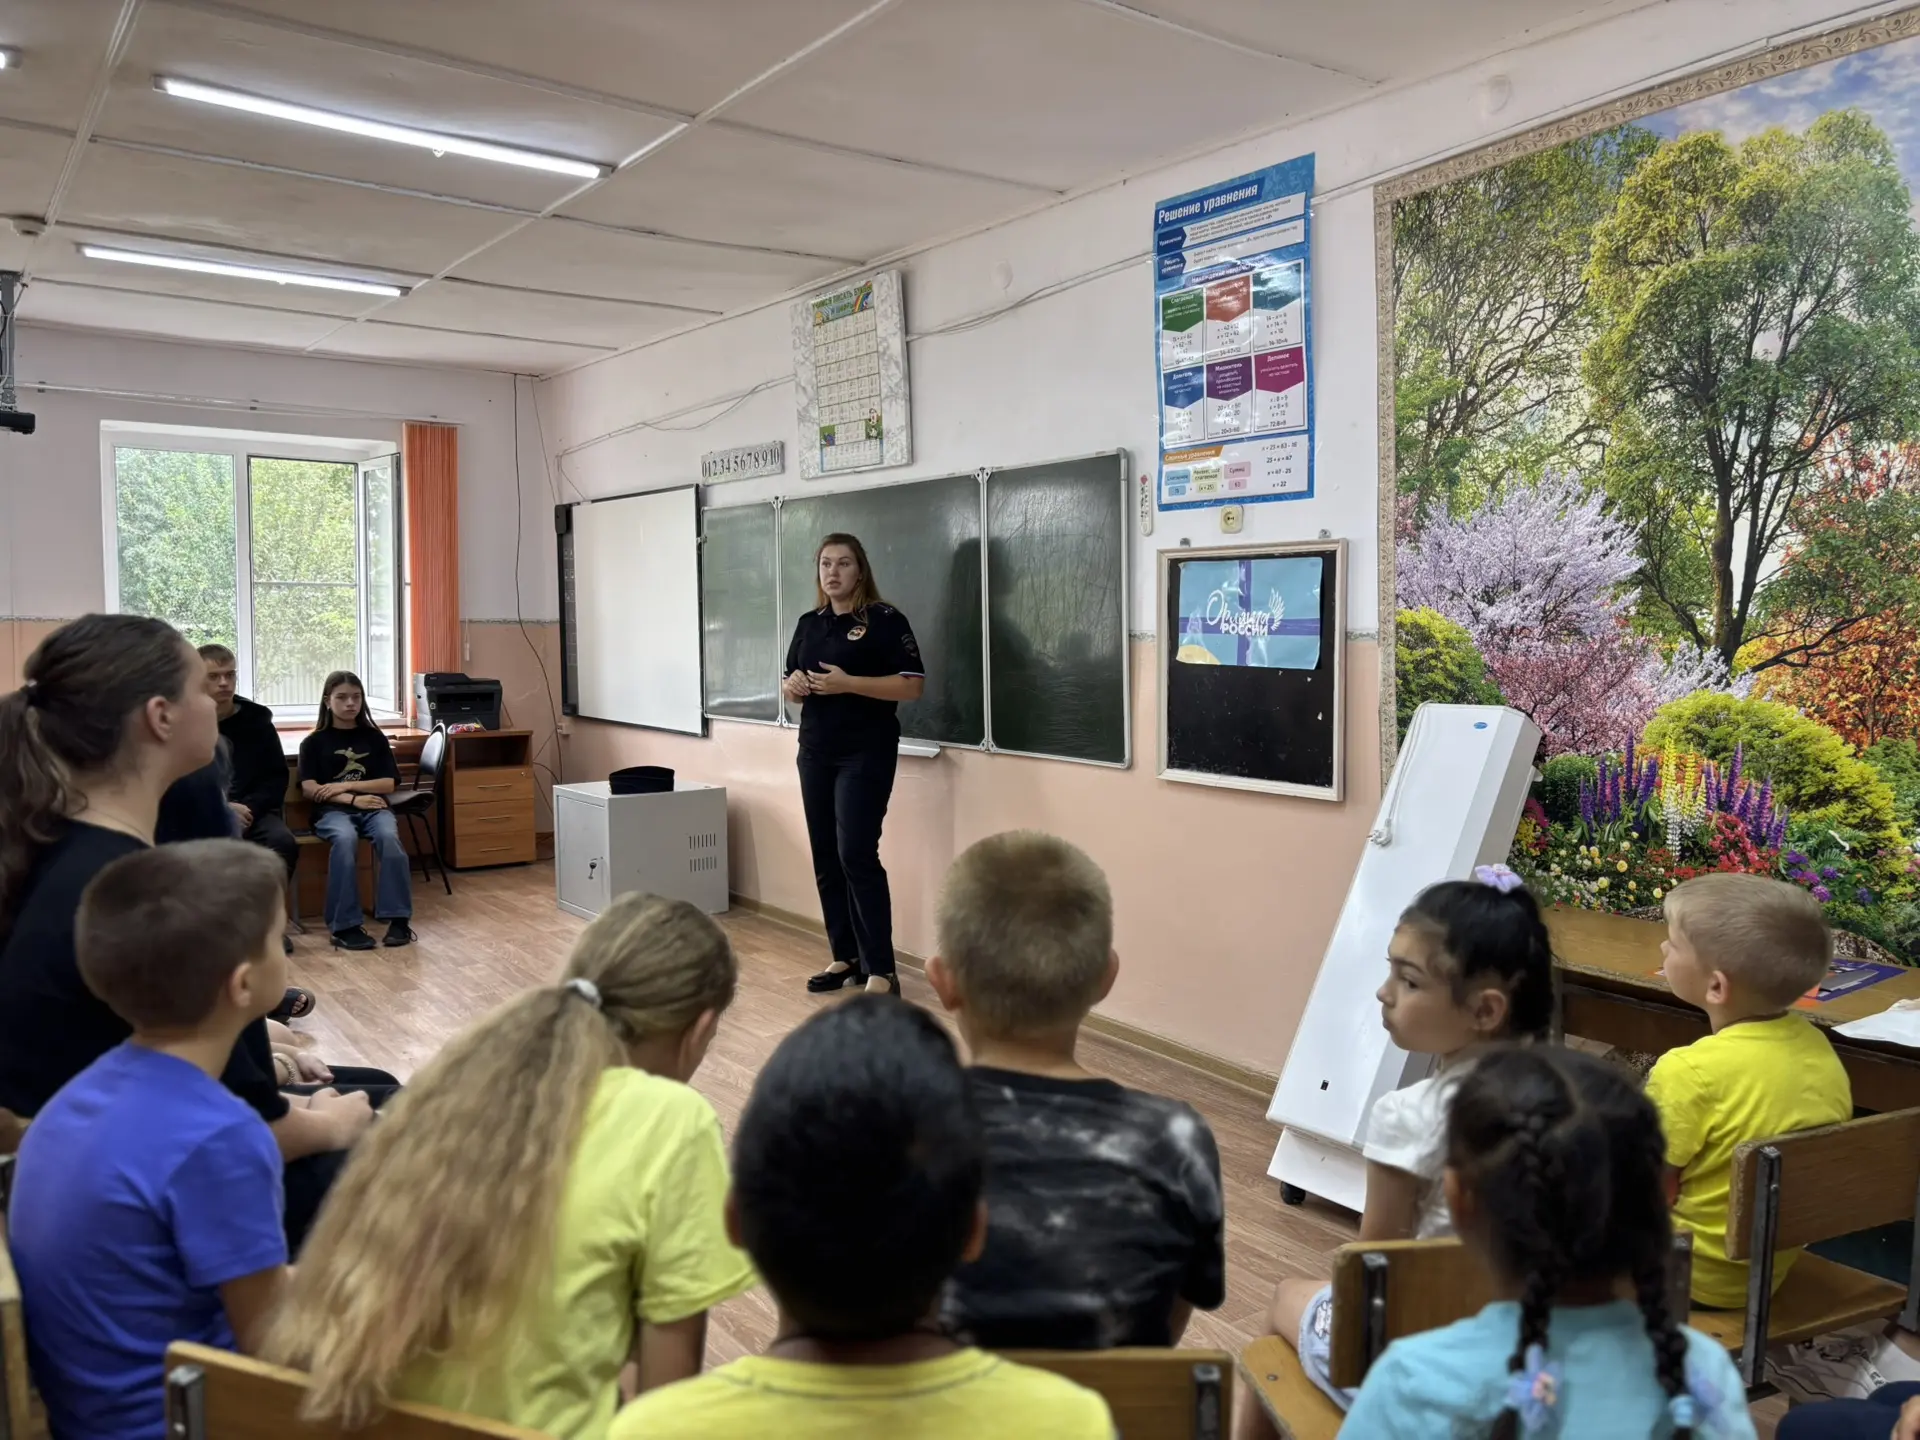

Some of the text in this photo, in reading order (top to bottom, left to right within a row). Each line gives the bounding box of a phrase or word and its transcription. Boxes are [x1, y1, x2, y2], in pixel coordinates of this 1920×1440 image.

[1158, 202, 1201, 224] Решение
[1203, 183, 1258, 213] уравнения
[1220, 622, 1269, 637] РОССИИ
